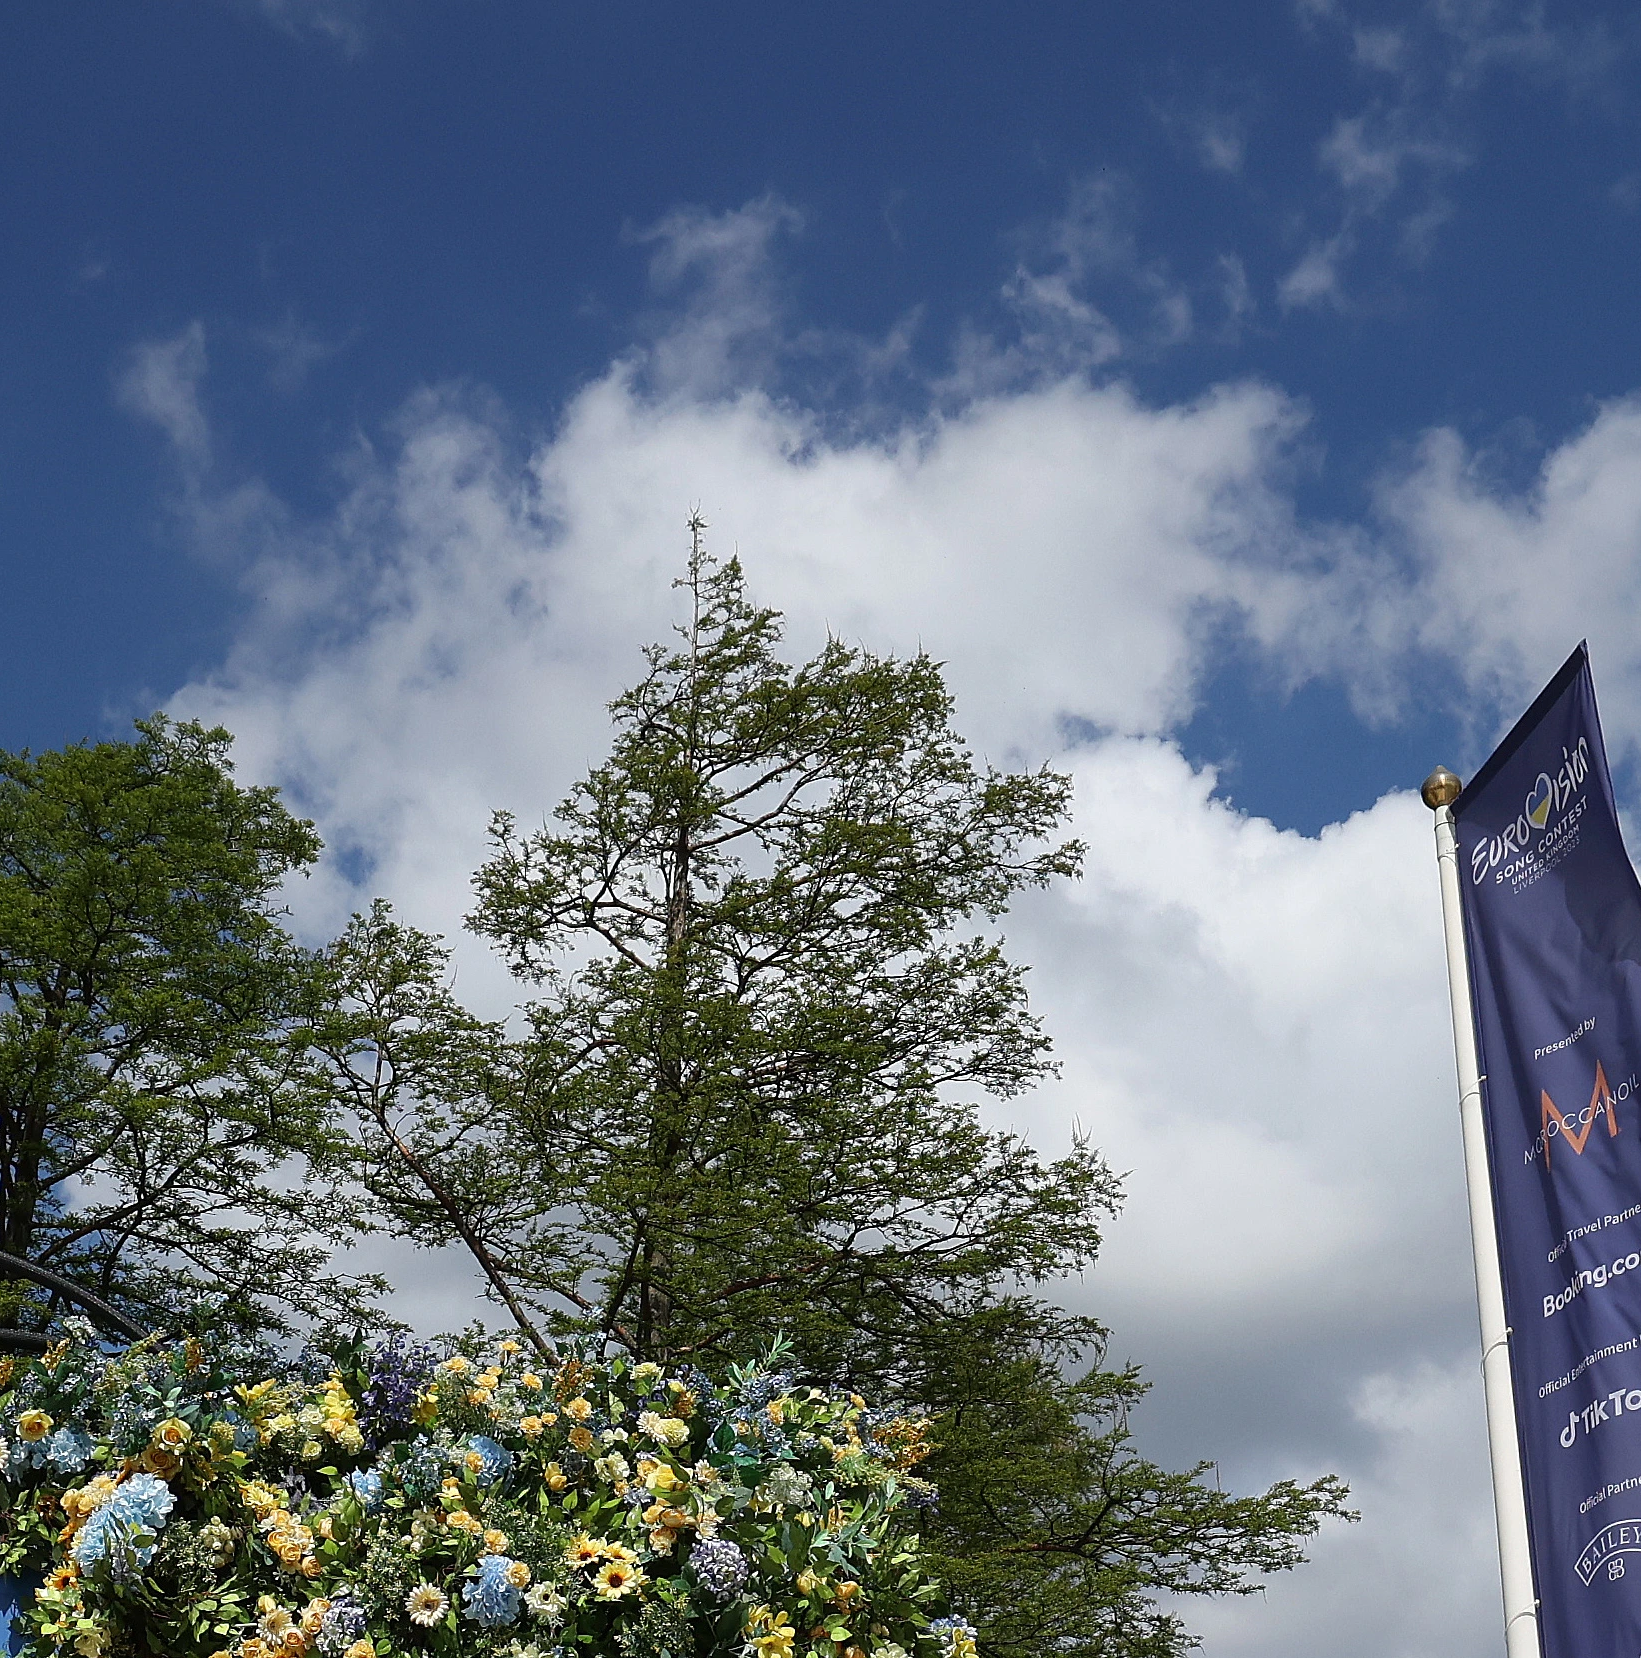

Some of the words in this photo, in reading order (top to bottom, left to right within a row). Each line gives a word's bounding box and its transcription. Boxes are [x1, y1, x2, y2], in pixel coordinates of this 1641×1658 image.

[1495, 851, 1535, 884] SONG
[1538, 795, 1588, 853] CONTEST
[1511, 859, 1544, 885] UNITED
[1545, 824, 1580, 861] KINGDOM
[1513, 857, 1561, 894] LIVERPOOL
[1534, 1023, 1583, 1060] Presented
[1584, 1017, 1596, 1031] by
[1524, 1074, 1640, 1165] MOROCCANOIL
[1566, 1218, 1602, 1242] Travel
[1538, 1372, 1570, 1398] Official
[1571, 1339, 1637, 1380] Entertainment
[1579, 1487, 1606, 1514] Official
